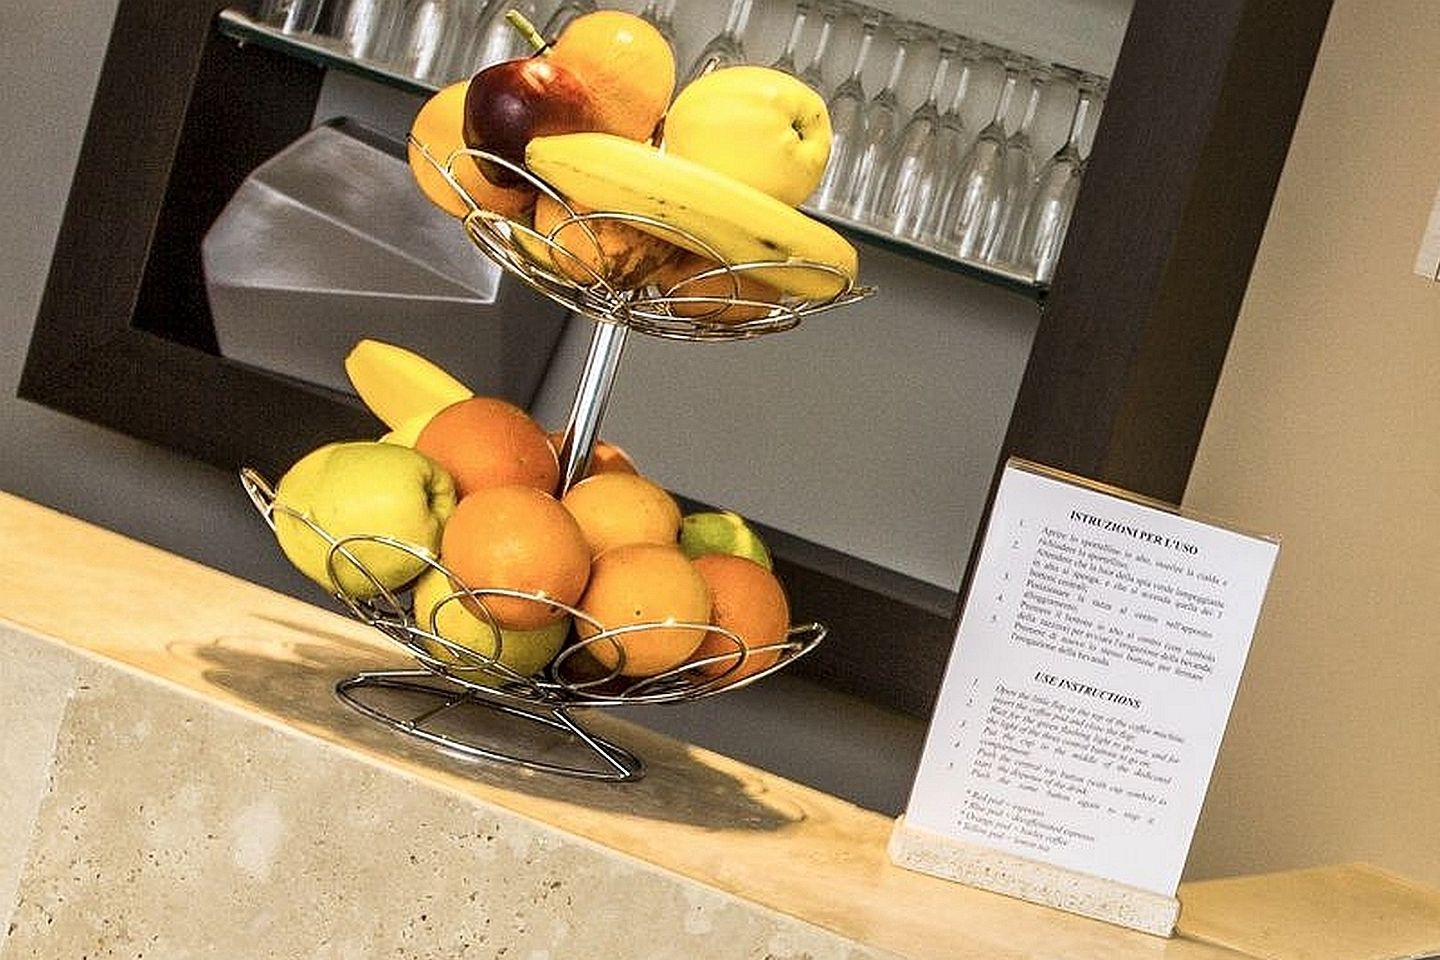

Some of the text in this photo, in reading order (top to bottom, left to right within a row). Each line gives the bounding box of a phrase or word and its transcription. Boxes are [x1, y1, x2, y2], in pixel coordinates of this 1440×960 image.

[1069, 511, 1138, 536] ISTRUZIONI
[1138, 529, 1165, 544] PER
[1033, 671, 1056, 684] USE
[1057, 678, 1141, 707] INSTRUCTIONS
